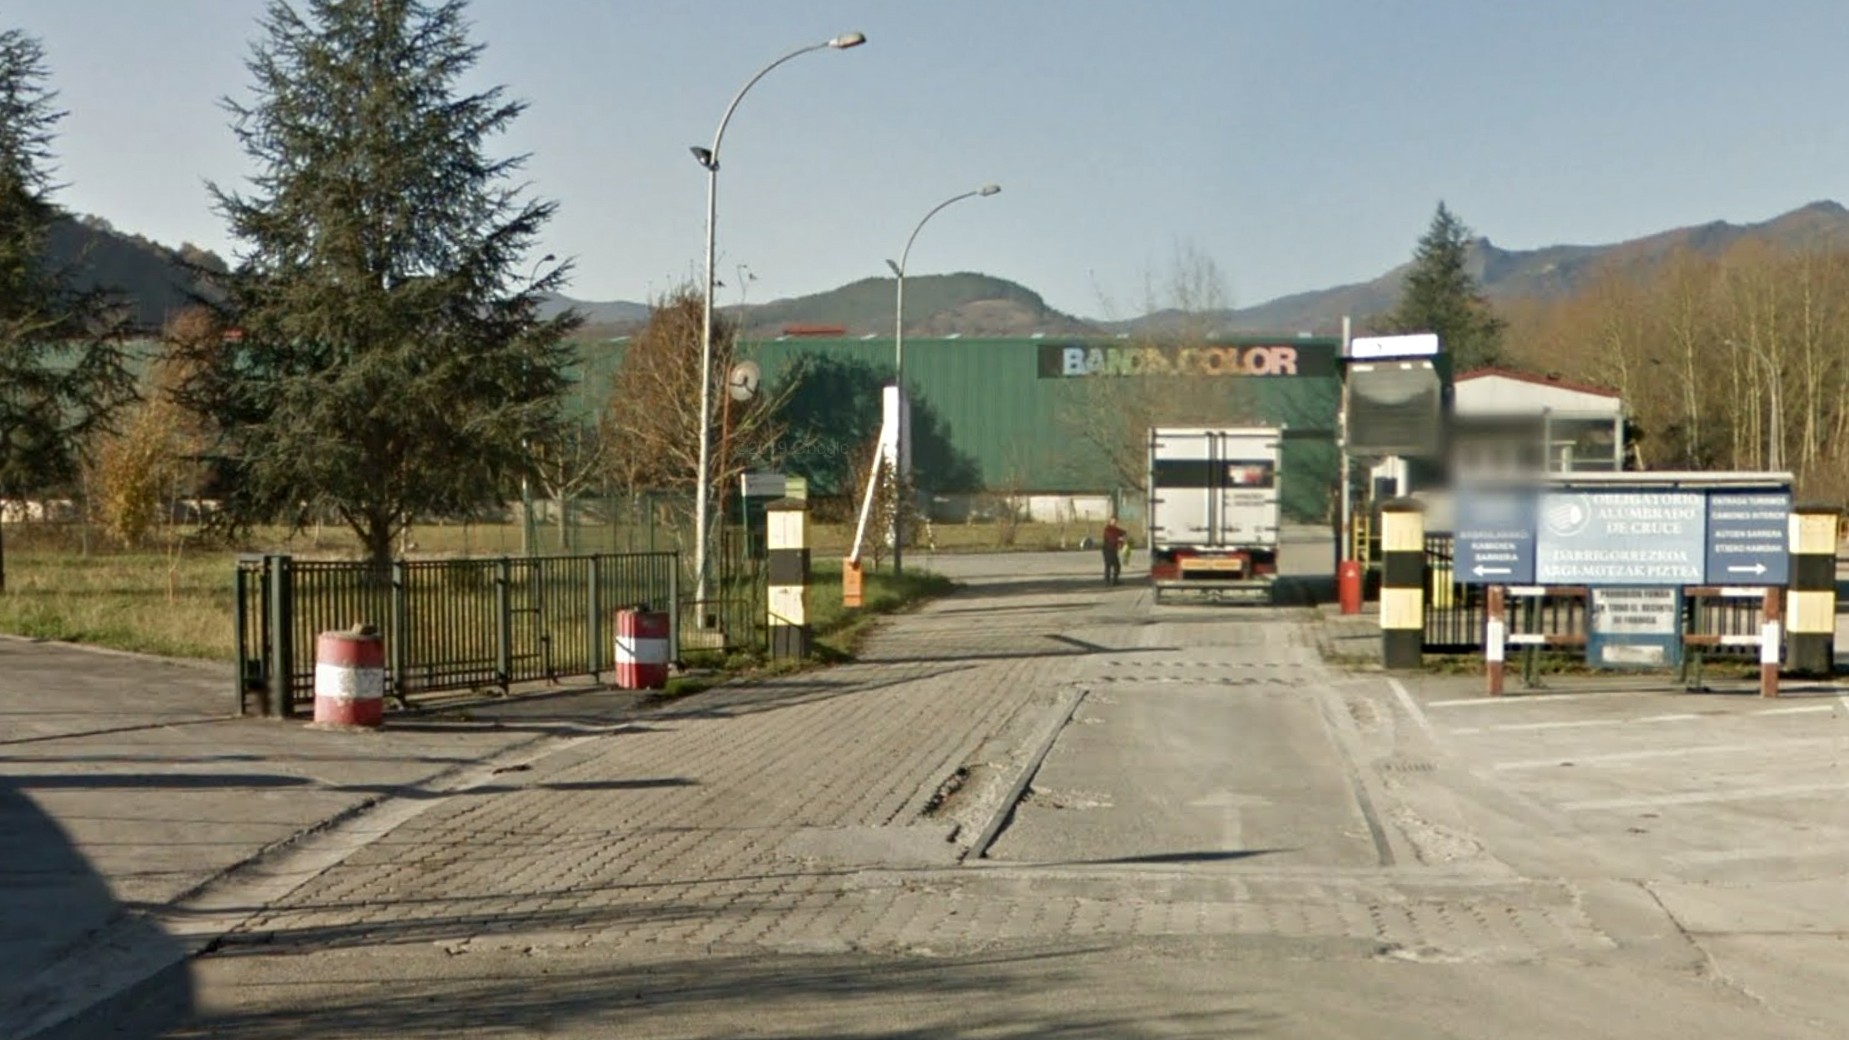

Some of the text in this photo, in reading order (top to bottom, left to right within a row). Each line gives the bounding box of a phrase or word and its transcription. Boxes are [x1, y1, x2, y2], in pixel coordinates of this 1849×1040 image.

[1598, 508, 1696, 519] ALUMBRADO
[1606, 522, 1683, 534] DE CRUCE
